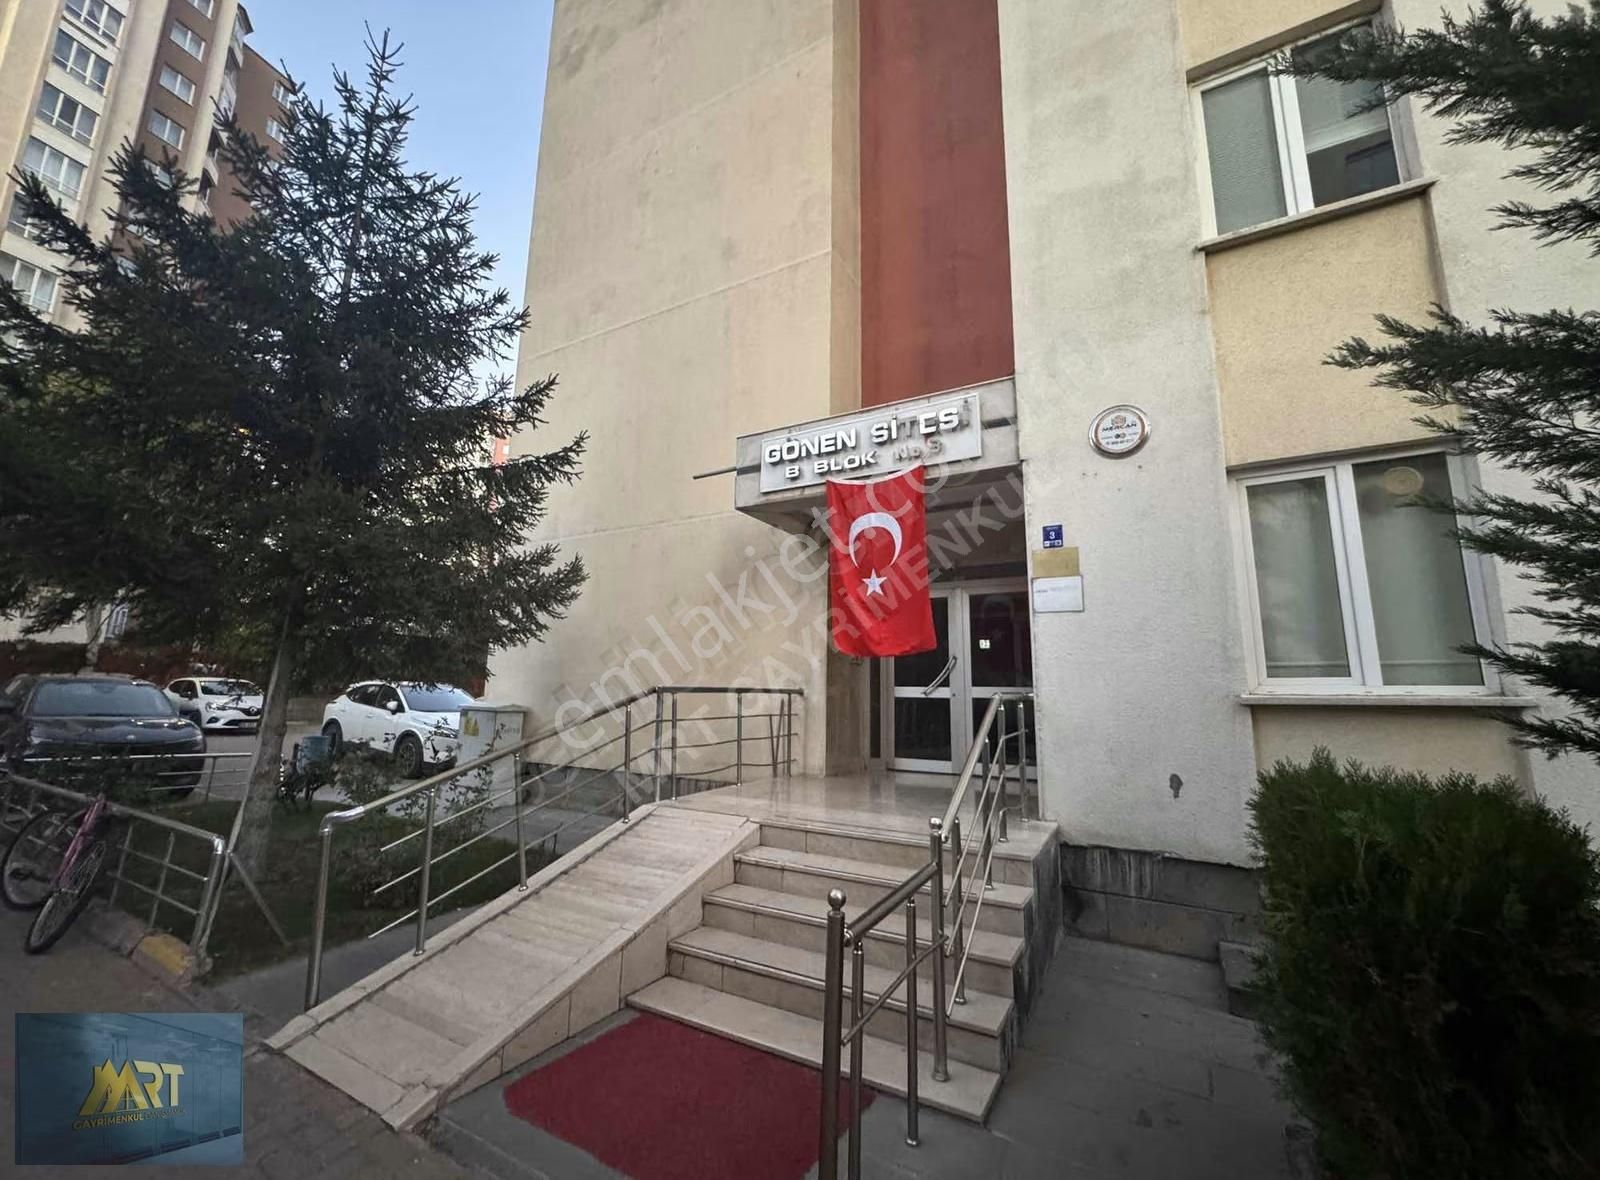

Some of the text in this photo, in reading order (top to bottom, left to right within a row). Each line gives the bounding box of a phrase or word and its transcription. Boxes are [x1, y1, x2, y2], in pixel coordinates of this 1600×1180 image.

[765, 428, 856, 463] GÖNEN
[785, 465, 801, 479] B
[813, 450, 877, 474] BLOK
[1049, 531, 1056, 540] 3
